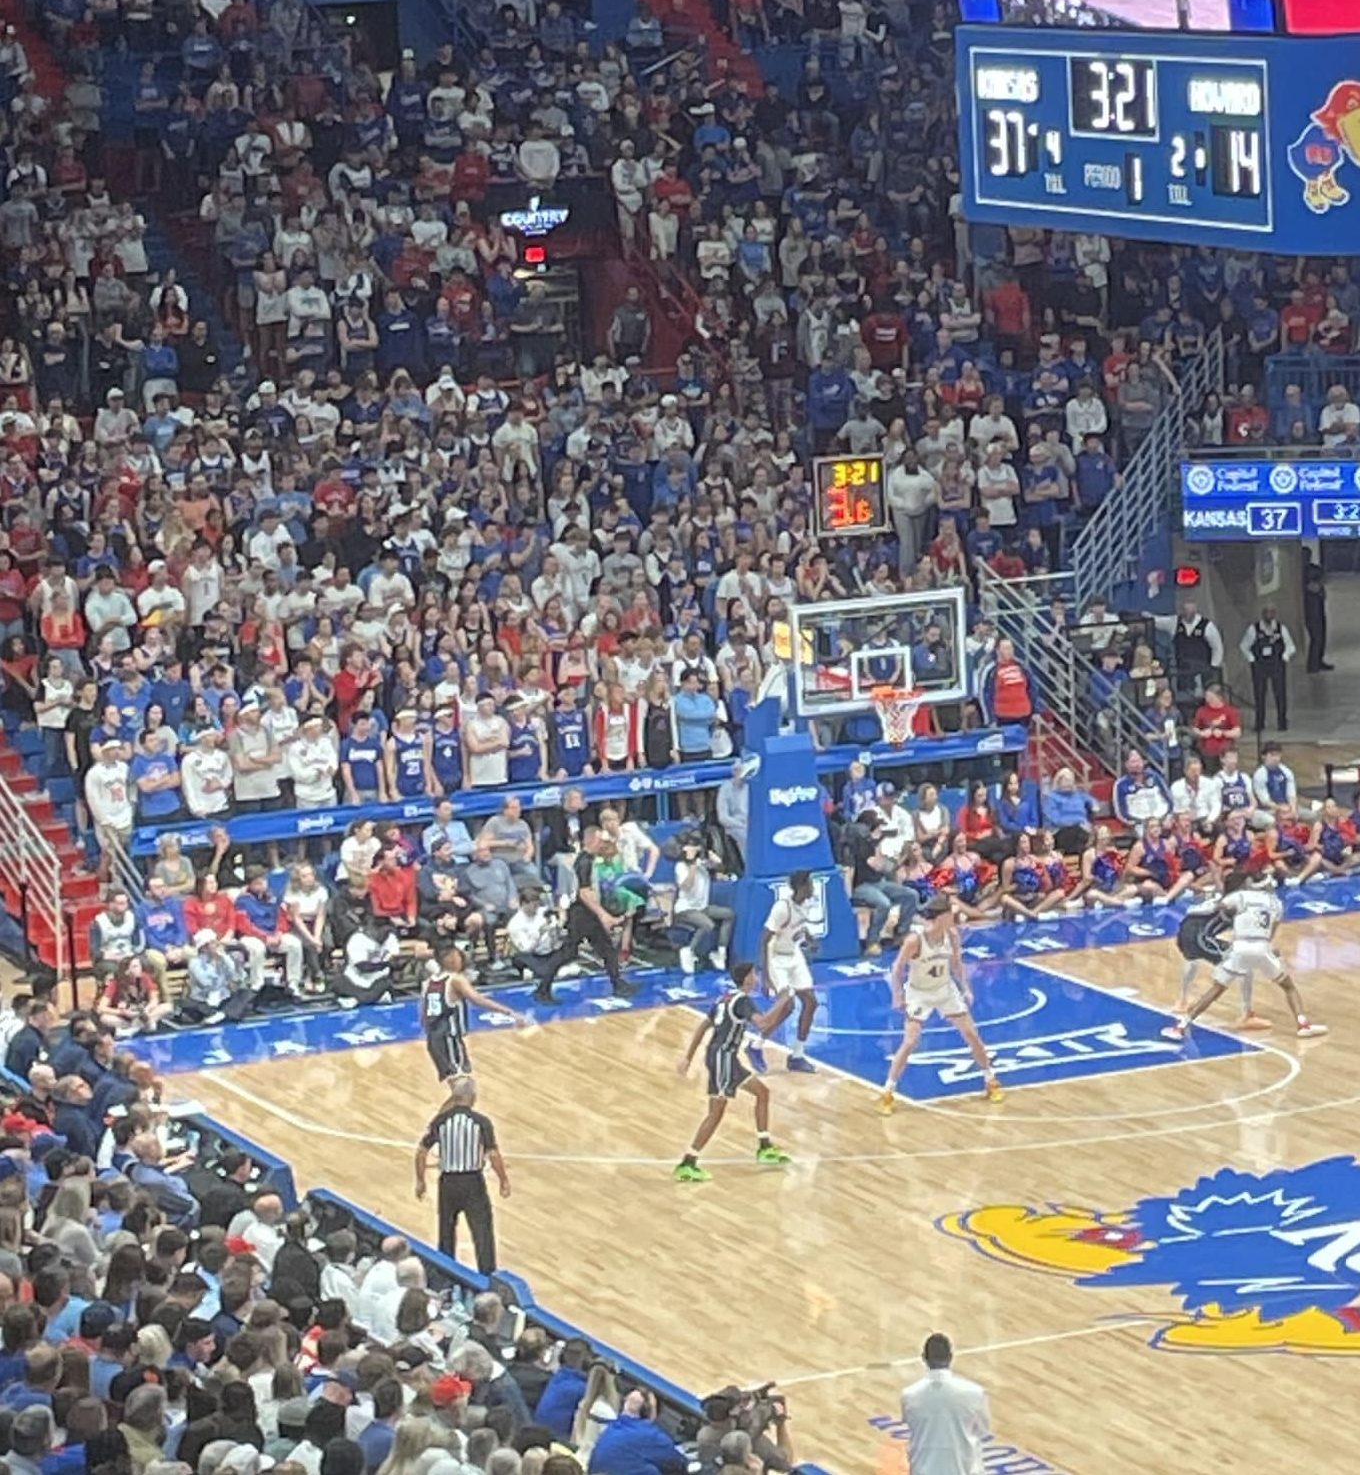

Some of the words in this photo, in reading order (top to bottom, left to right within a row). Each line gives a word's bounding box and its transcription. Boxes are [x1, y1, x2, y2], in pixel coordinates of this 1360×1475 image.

[989, 110, 1026, 176] 37
[1171, 134, 1186, 177] 2
[1230, 128, 1260, 194] 14
[1131, 155, 1143, 202] 1
[833, 461, 879, 487] 3:21
[1183, 510, 1248, 528] KANSAS
[1260, 508, 1288, 531] 37
